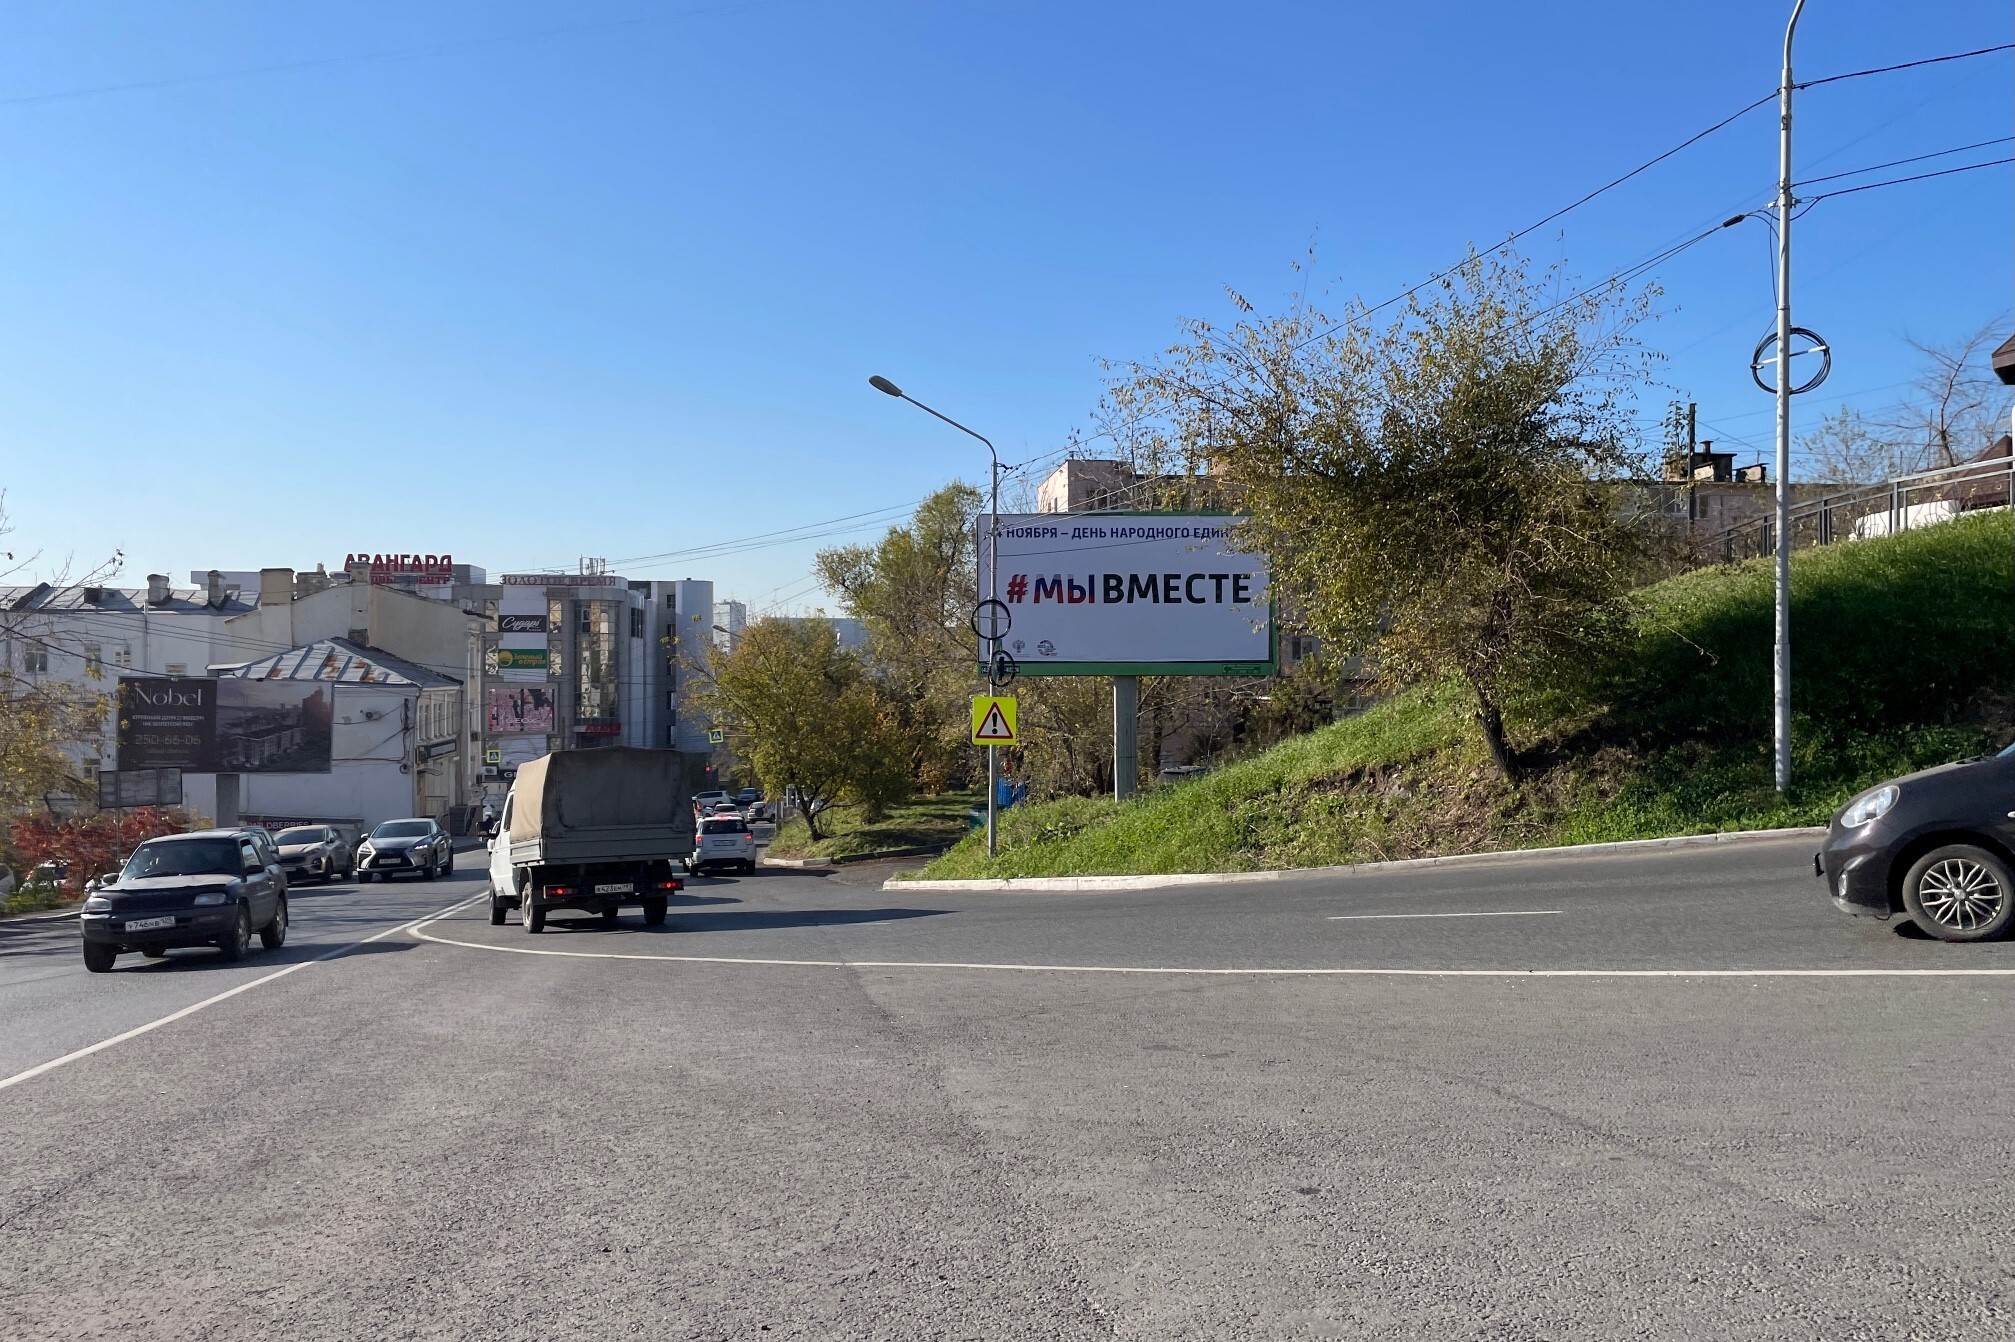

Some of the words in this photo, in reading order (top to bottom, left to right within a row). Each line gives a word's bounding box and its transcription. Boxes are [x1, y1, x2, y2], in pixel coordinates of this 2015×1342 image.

[1006, 527, 1057, 538] НОЯБРЯ
[1071, 527, 1106, 540] ДЕНЬ
[1110, 527, 1190, 539] НАРОДНОГО
[418, 575, 449, 585] ЕНТР
[134, 687, 202, 706] Nobel
